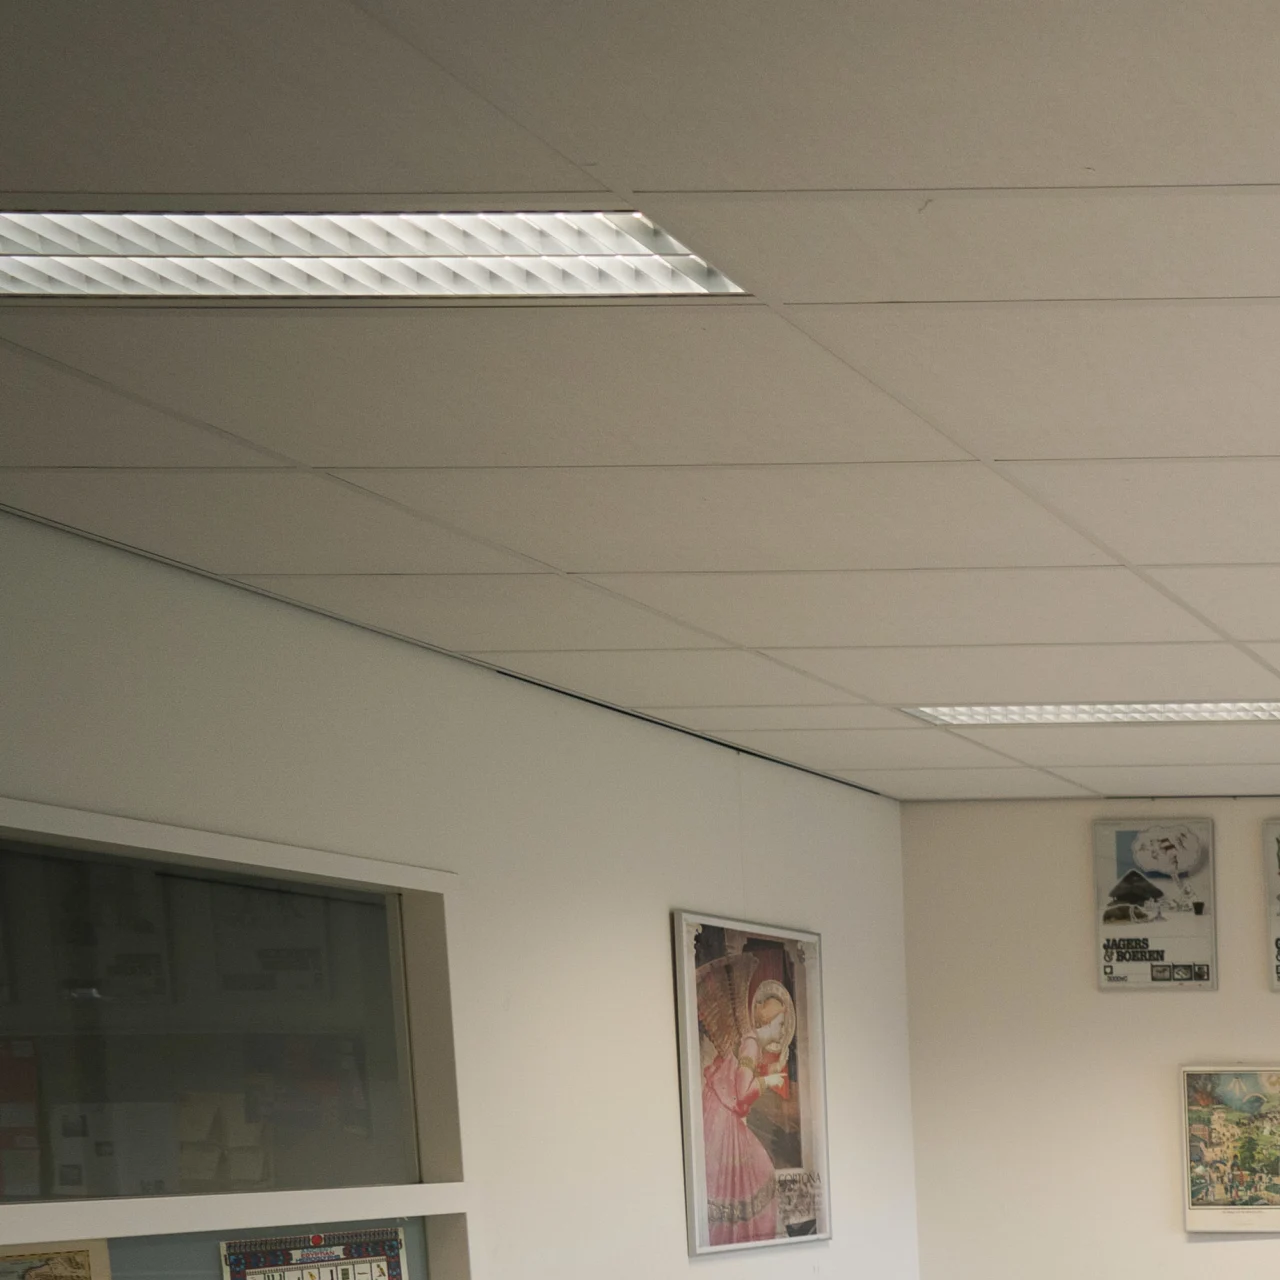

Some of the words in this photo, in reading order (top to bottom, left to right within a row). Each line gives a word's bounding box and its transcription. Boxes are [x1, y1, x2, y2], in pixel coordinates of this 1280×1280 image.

[1103, 938, 1149, 950] JAGERS
[1104, 950, 1114, 962] &
[1116, 950, 1165, 962] BOEREN
[778, 1172, 822, 1185] CORTONA
